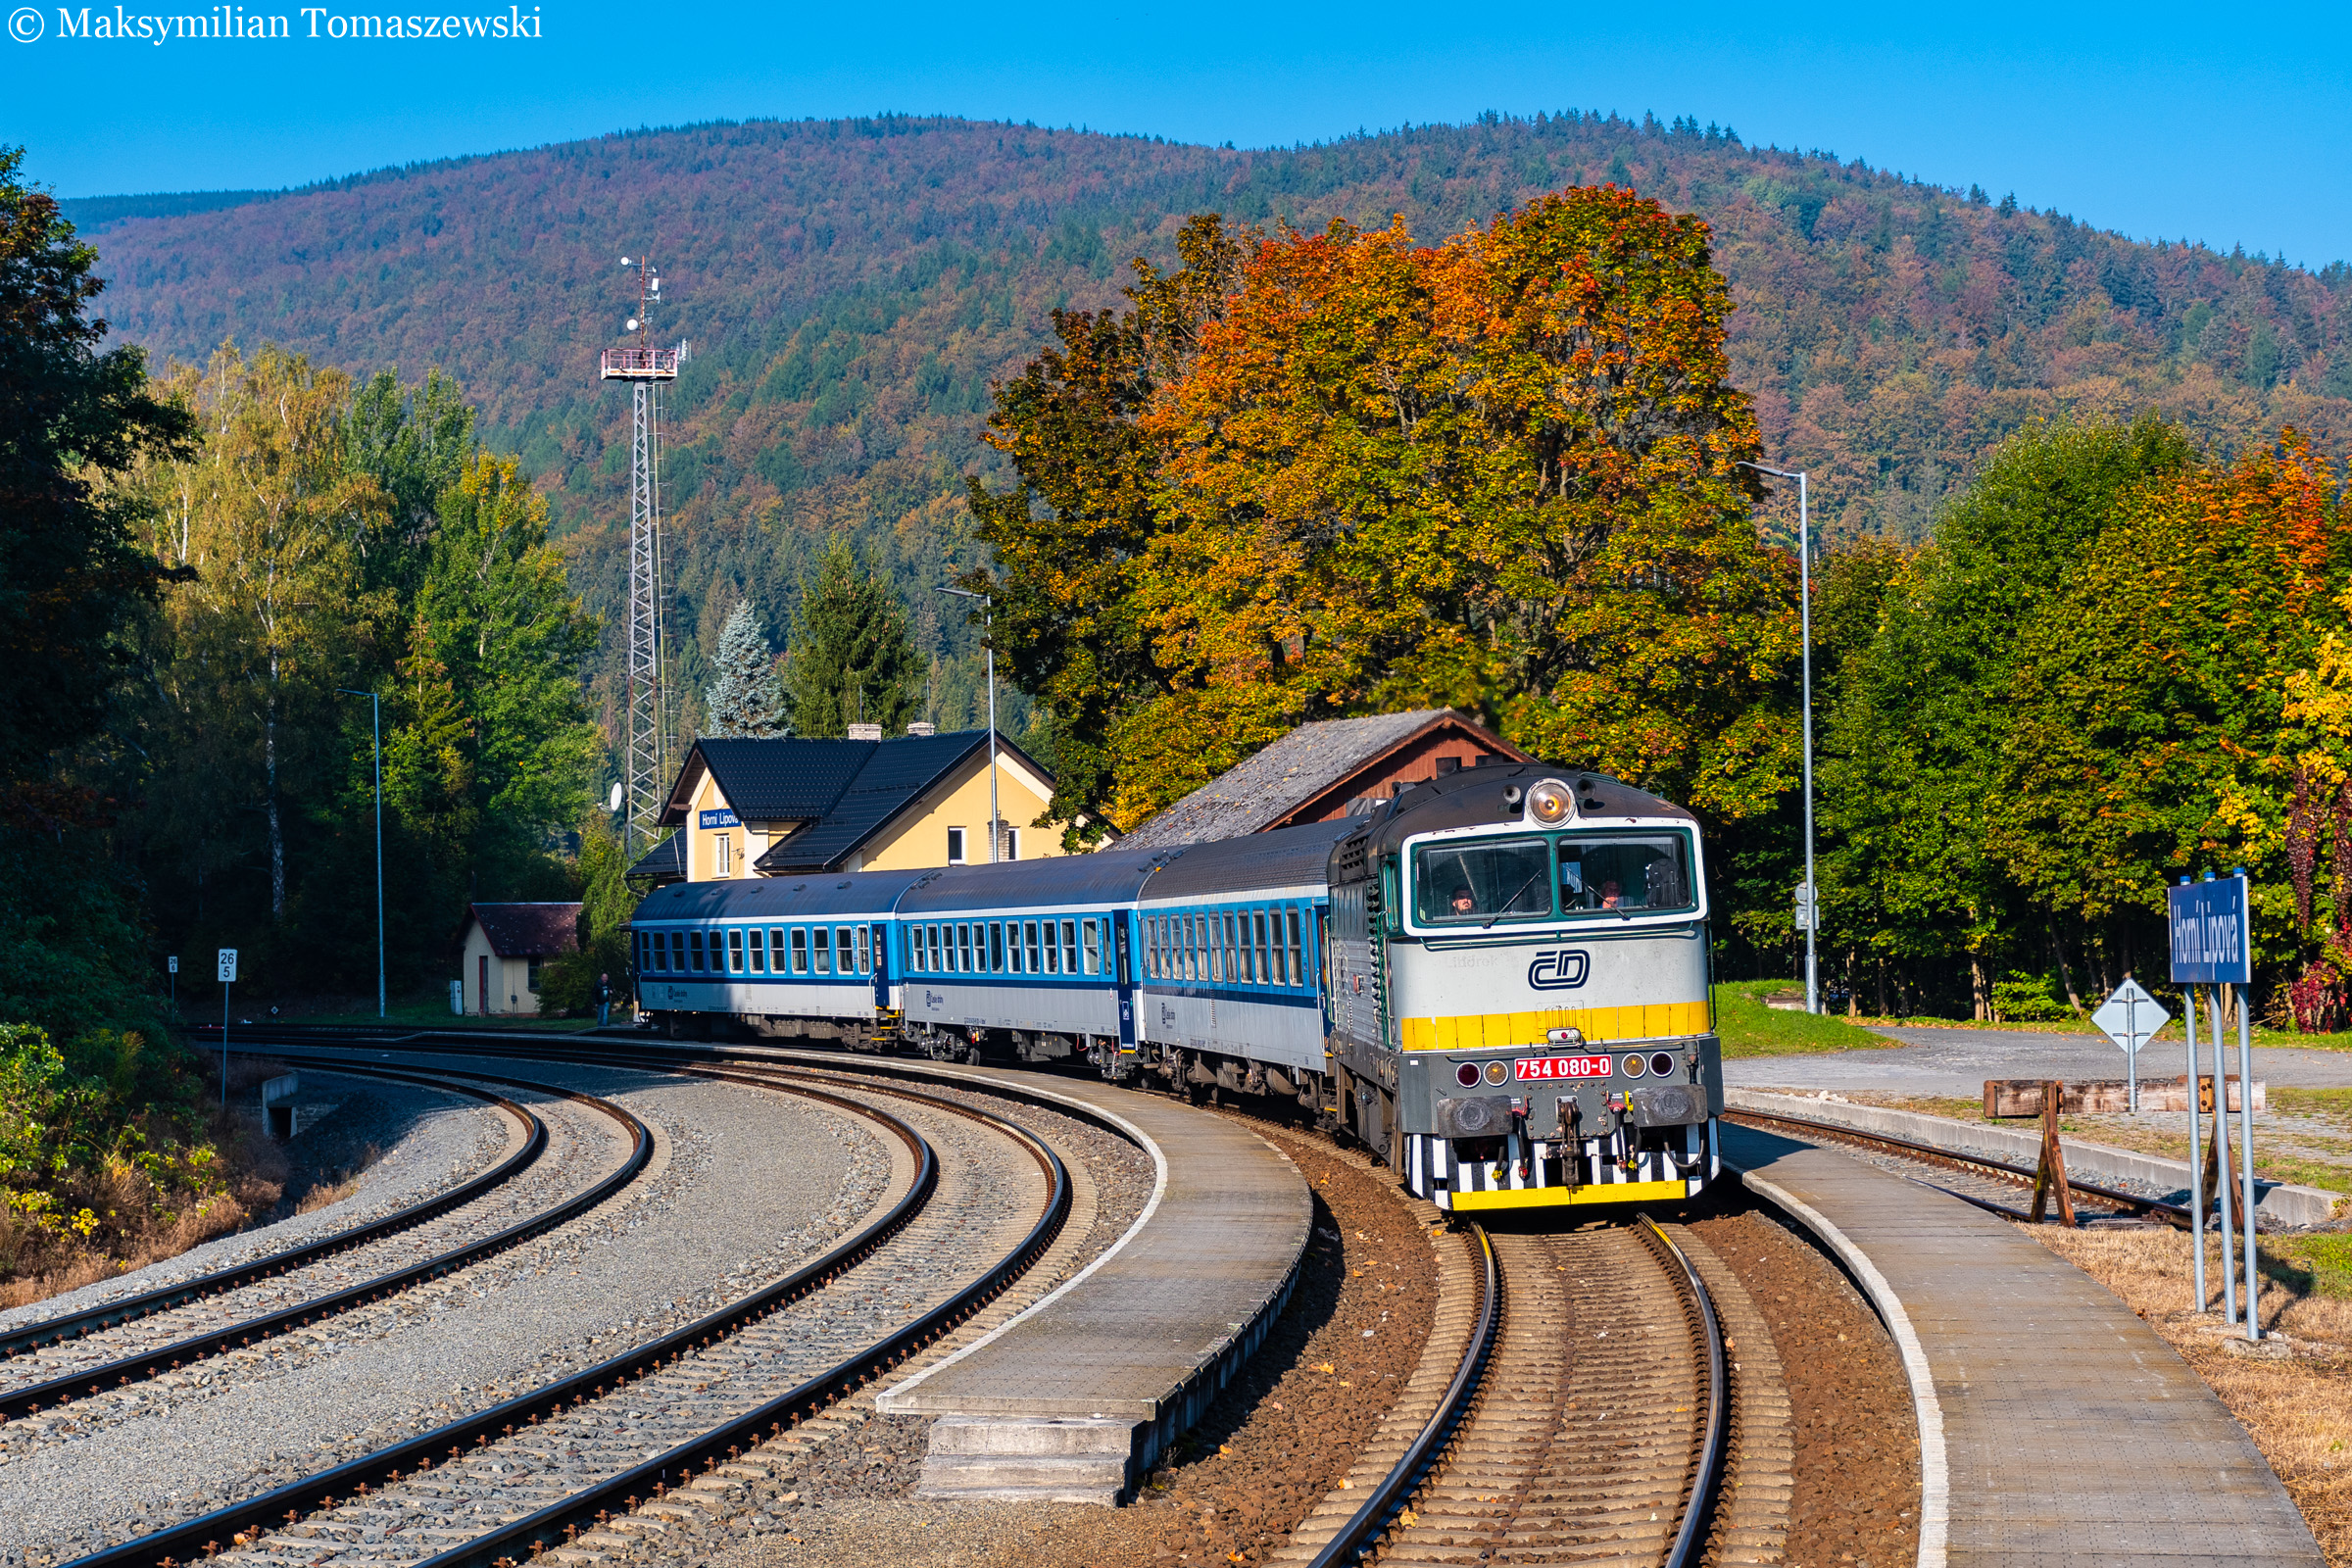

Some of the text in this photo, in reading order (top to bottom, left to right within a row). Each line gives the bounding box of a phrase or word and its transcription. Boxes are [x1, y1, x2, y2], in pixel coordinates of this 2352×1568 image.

[2174, 895, 2239, 980] Horní Lipová
[220, 953, 234, 964] 26
[222, 966, 230, 977] 5
[1517, 1057, 1610, 1078] 754 080-0
